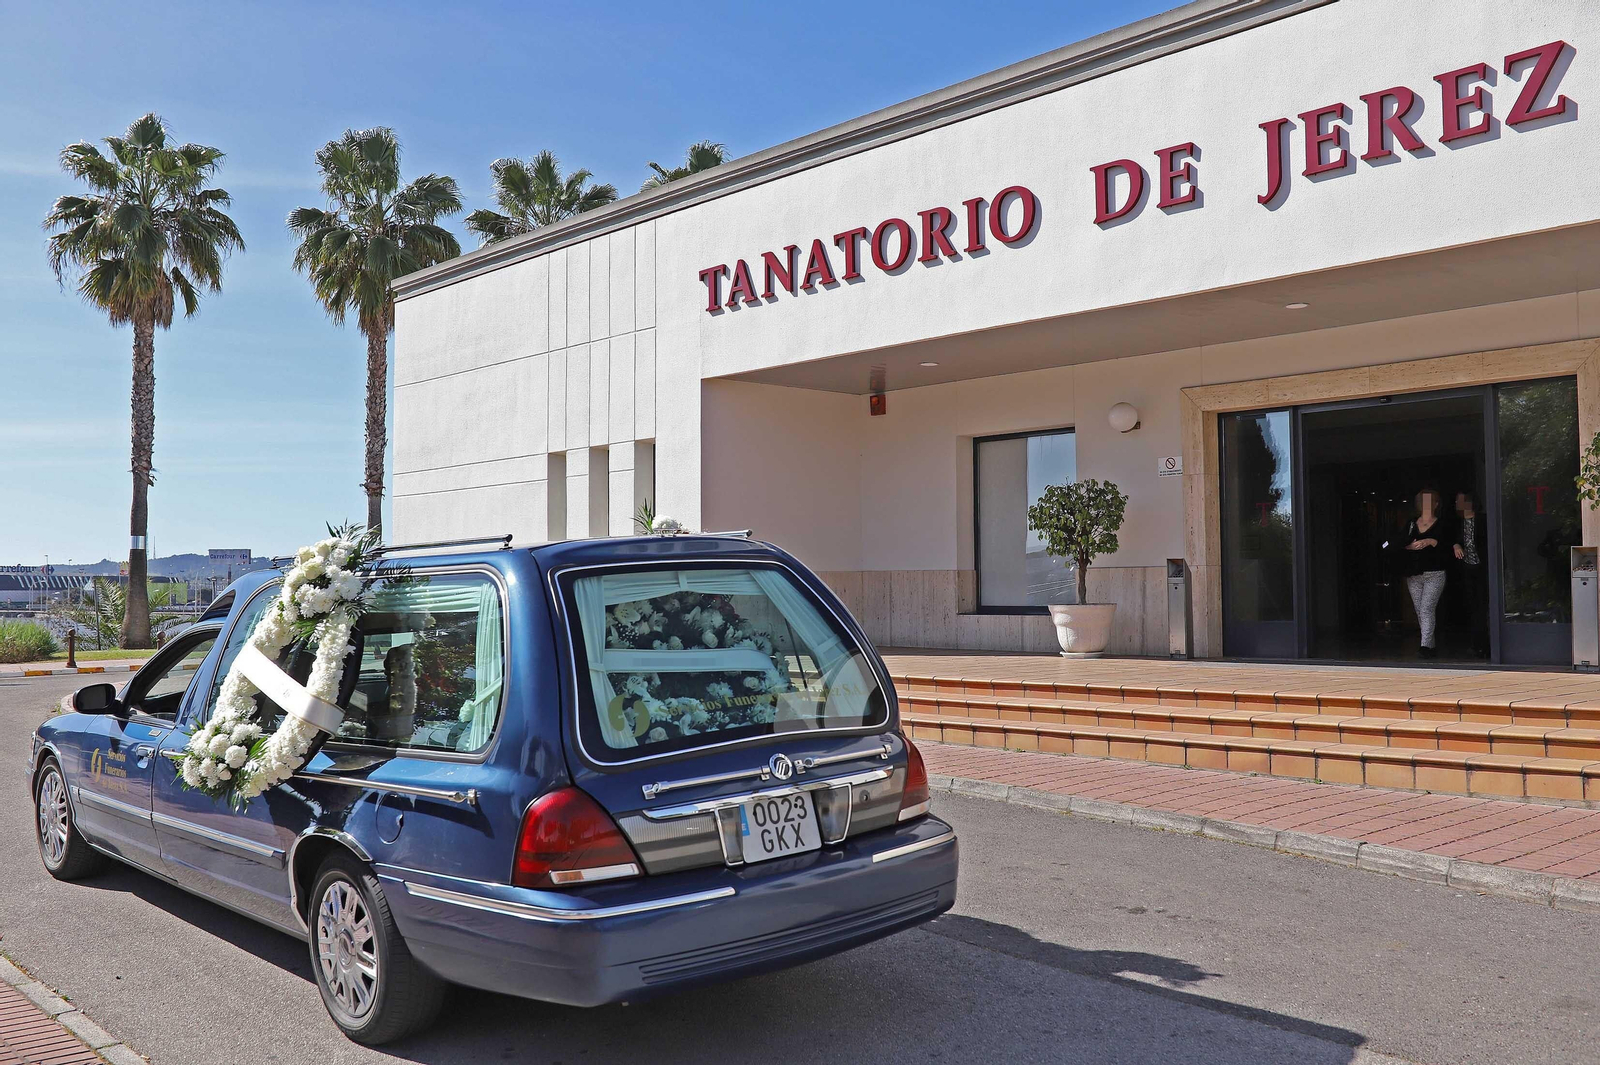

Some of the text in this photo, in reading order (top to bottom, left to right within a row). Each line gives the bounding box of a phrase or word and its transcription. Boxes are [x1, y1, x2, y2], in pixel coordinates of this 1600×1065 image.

[698, 40, 1567, 312] TANATORIO DE JEREZ
[1254, 502, 1274, 527] T
[1527, 485, 1550, 515] T
[0, 563, 37, 573] rrefour
[753, 795, 807, 827] 0023
[761, 822, 805, 853] GKX
